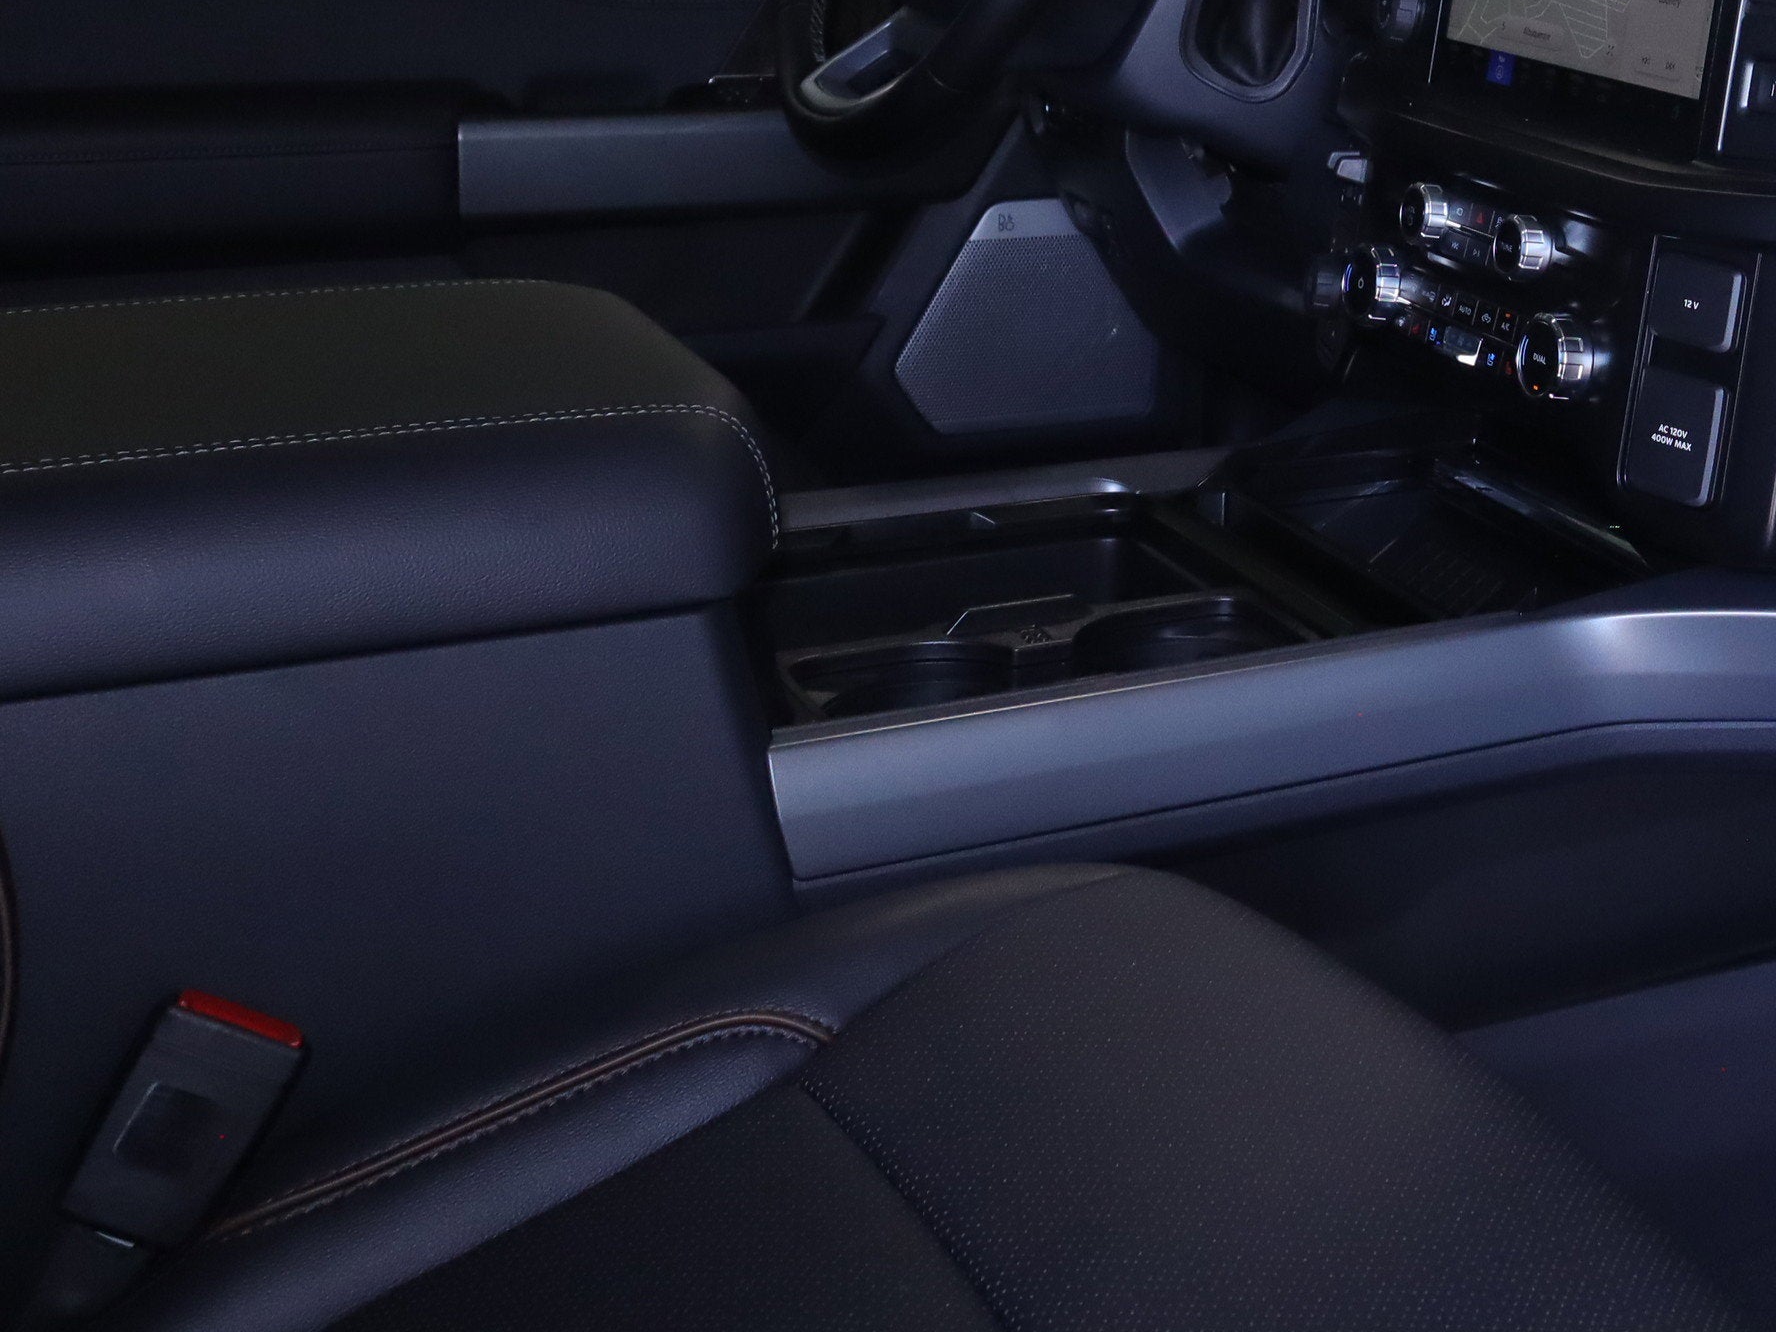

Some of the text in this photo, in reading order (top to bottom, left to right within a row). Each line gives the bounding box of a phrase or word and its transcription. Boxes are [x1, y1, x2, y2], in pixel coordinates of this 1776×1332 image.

[1458, 305, 1472, 316] AUTO
[1683, 298, 1700, 310] 12 V
[1532, 352, 1547, 366] DUAL
[1658, 423, 1688, 440] AC 120V
[1650, 432, 1692, 452] 400W MAX
